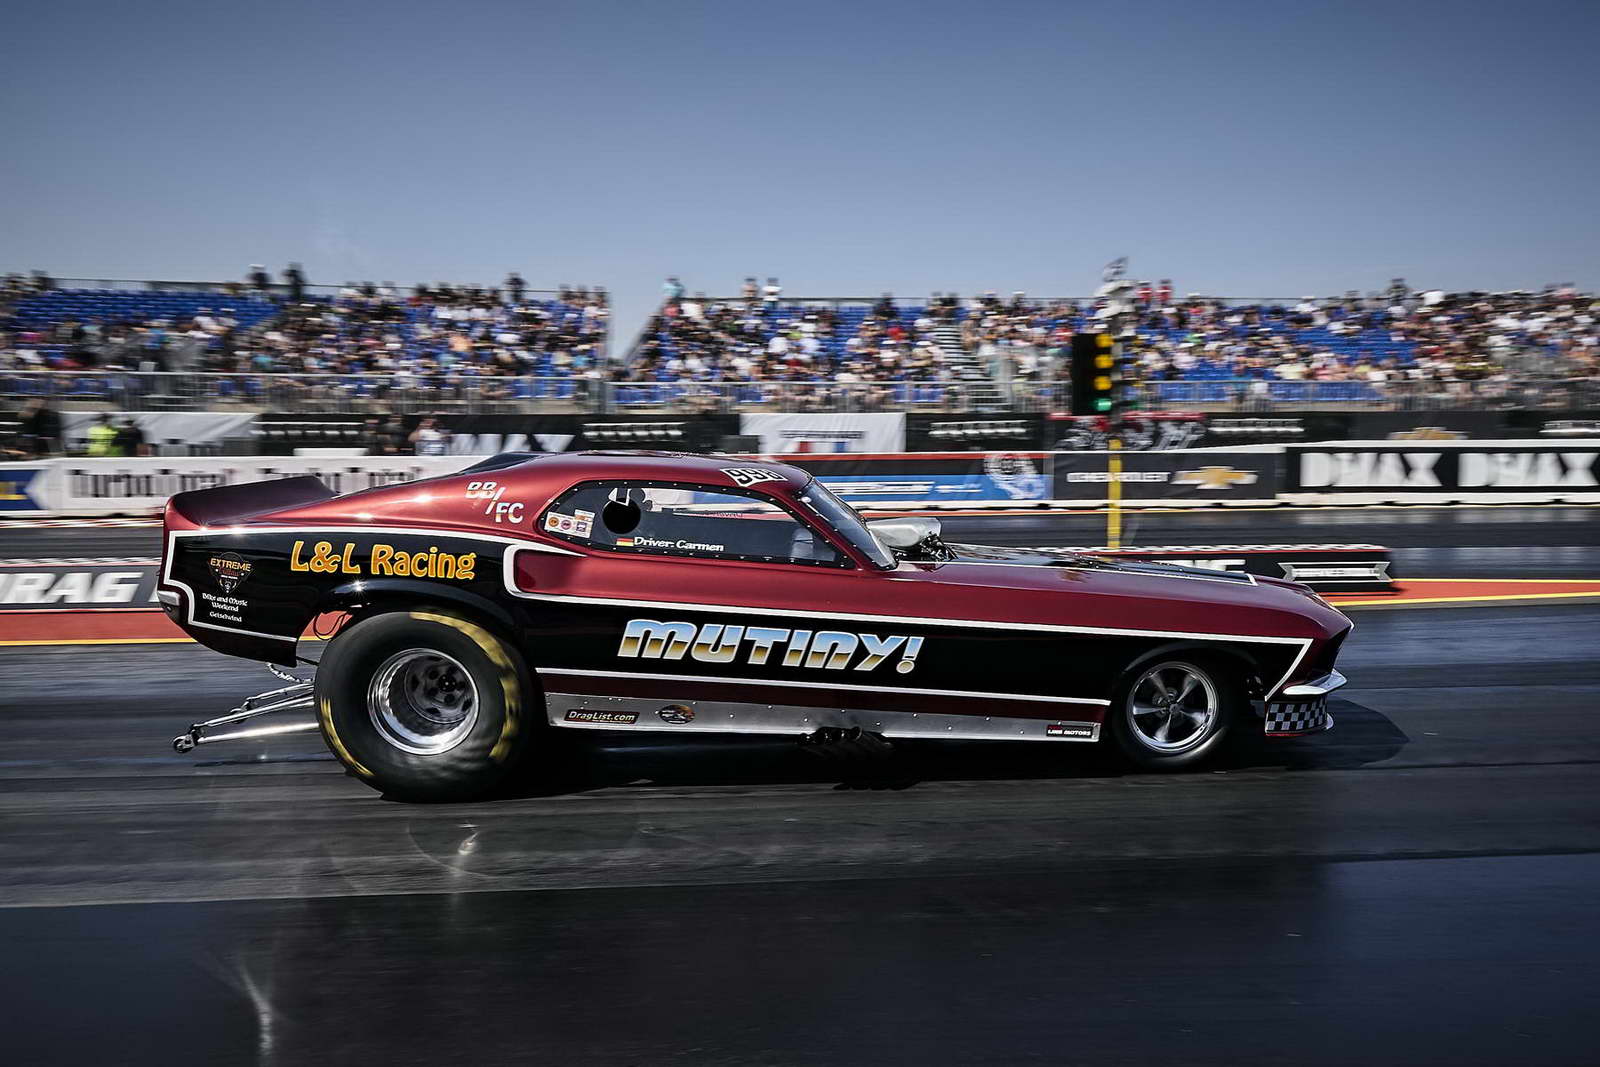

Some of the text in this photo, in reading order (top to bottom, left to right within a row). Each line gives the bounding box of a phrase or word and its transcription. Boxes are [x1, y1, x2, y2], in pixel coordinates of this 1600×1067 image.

[676, 540, 724, 552] Carmen
[211, 558, 251, 571] EXTREME
[290, 540, 477, 580] L&L Racing
[0, 571, 144, 604] RAG
[617, 617, 925, 674] MUTINY!
[568, 711, 635, 721] DragList.com
